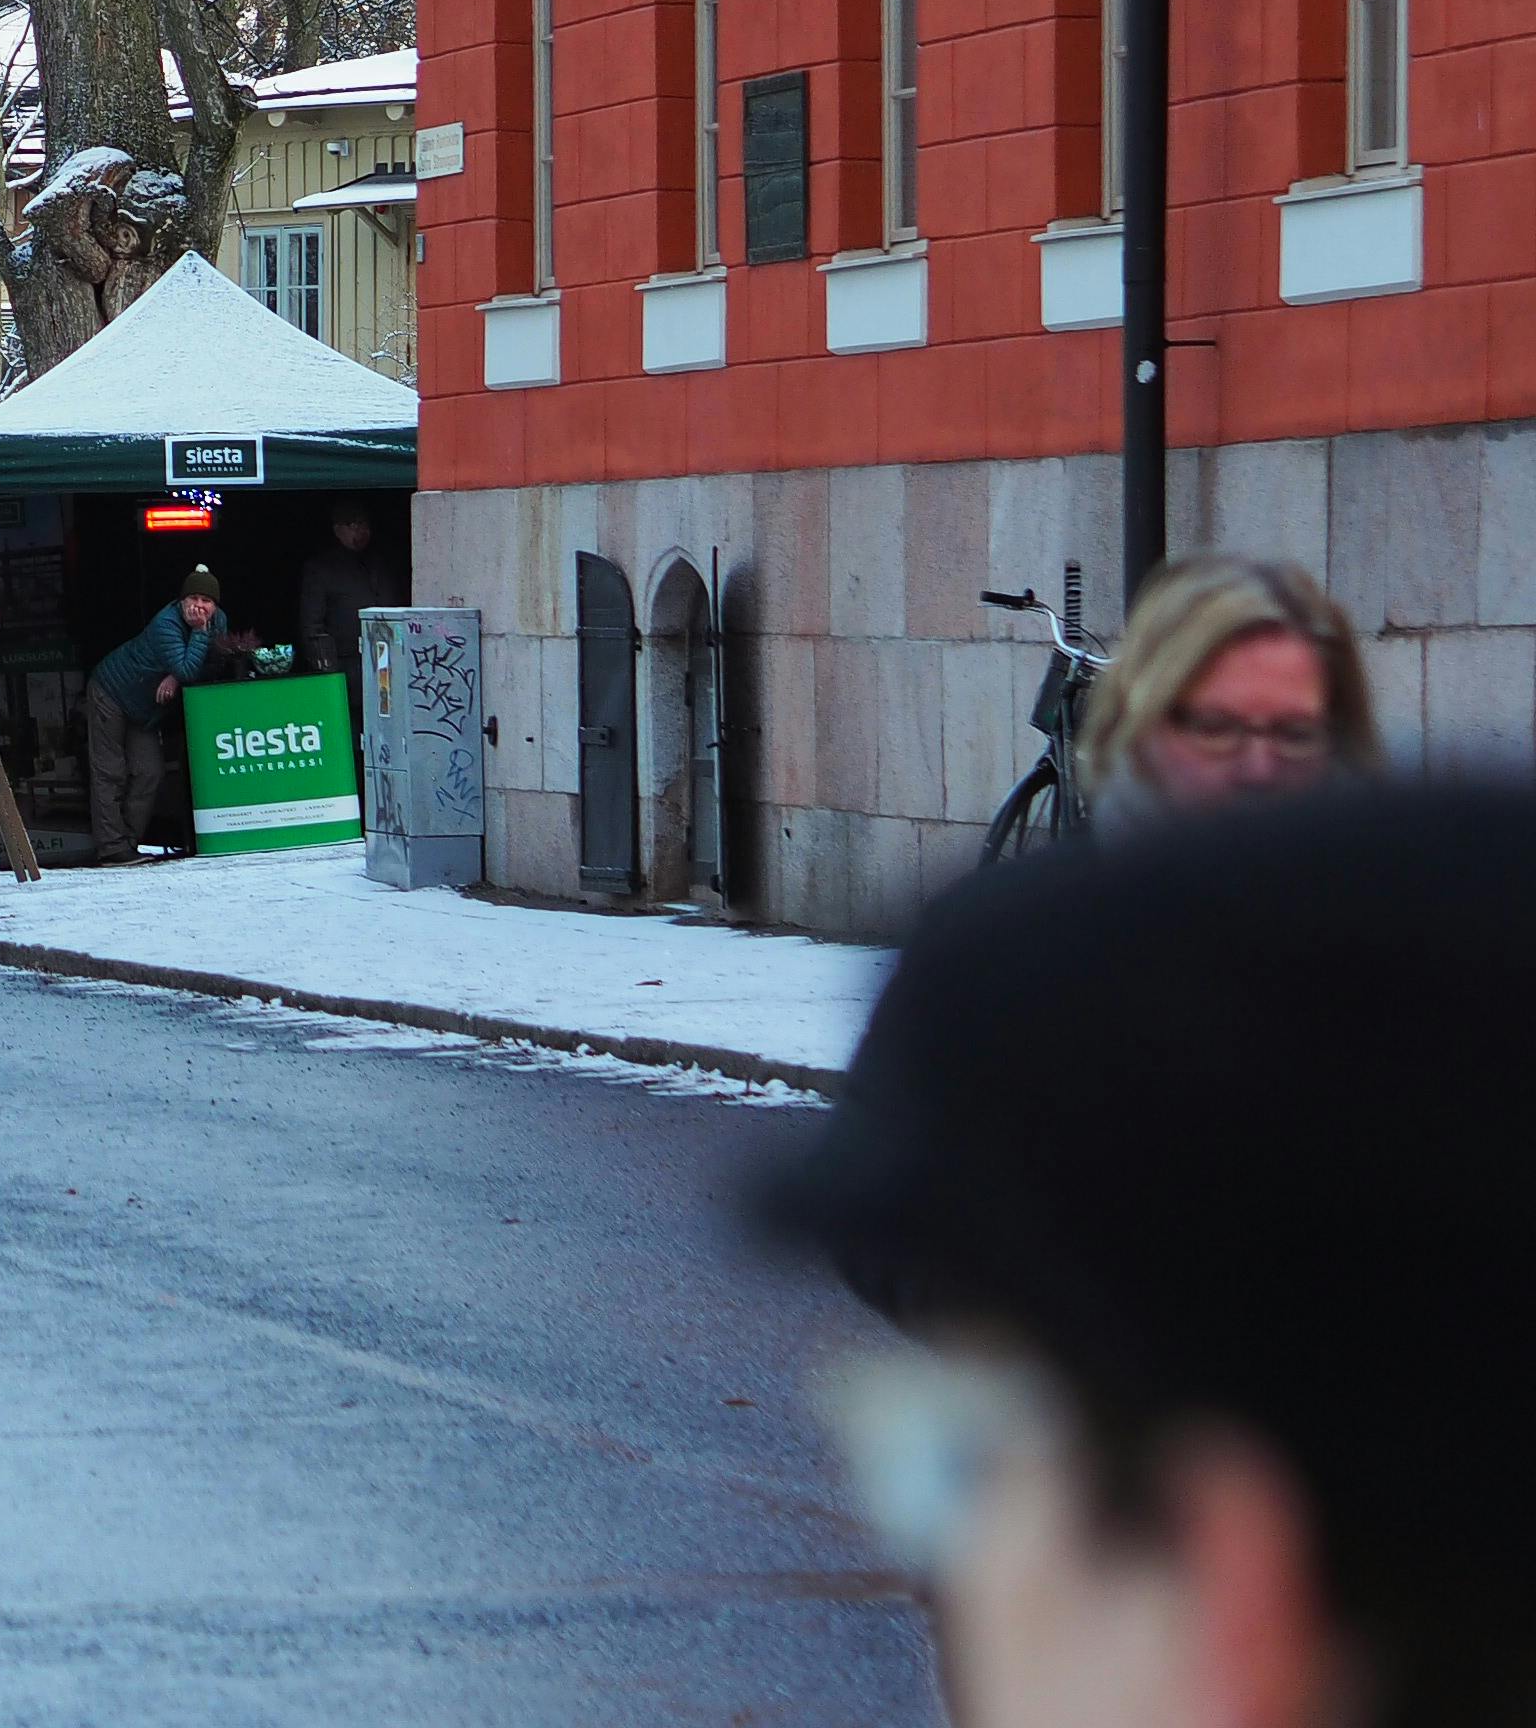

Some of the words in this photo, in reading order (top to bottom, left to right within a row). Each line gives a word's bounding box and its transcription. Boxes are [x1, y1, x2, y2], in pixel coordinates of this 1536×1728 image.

[185, 446, 243, 464] siesta
[215, 723, 321, 760] siesta
[218, 758, 323, 775] LASITERASSI
